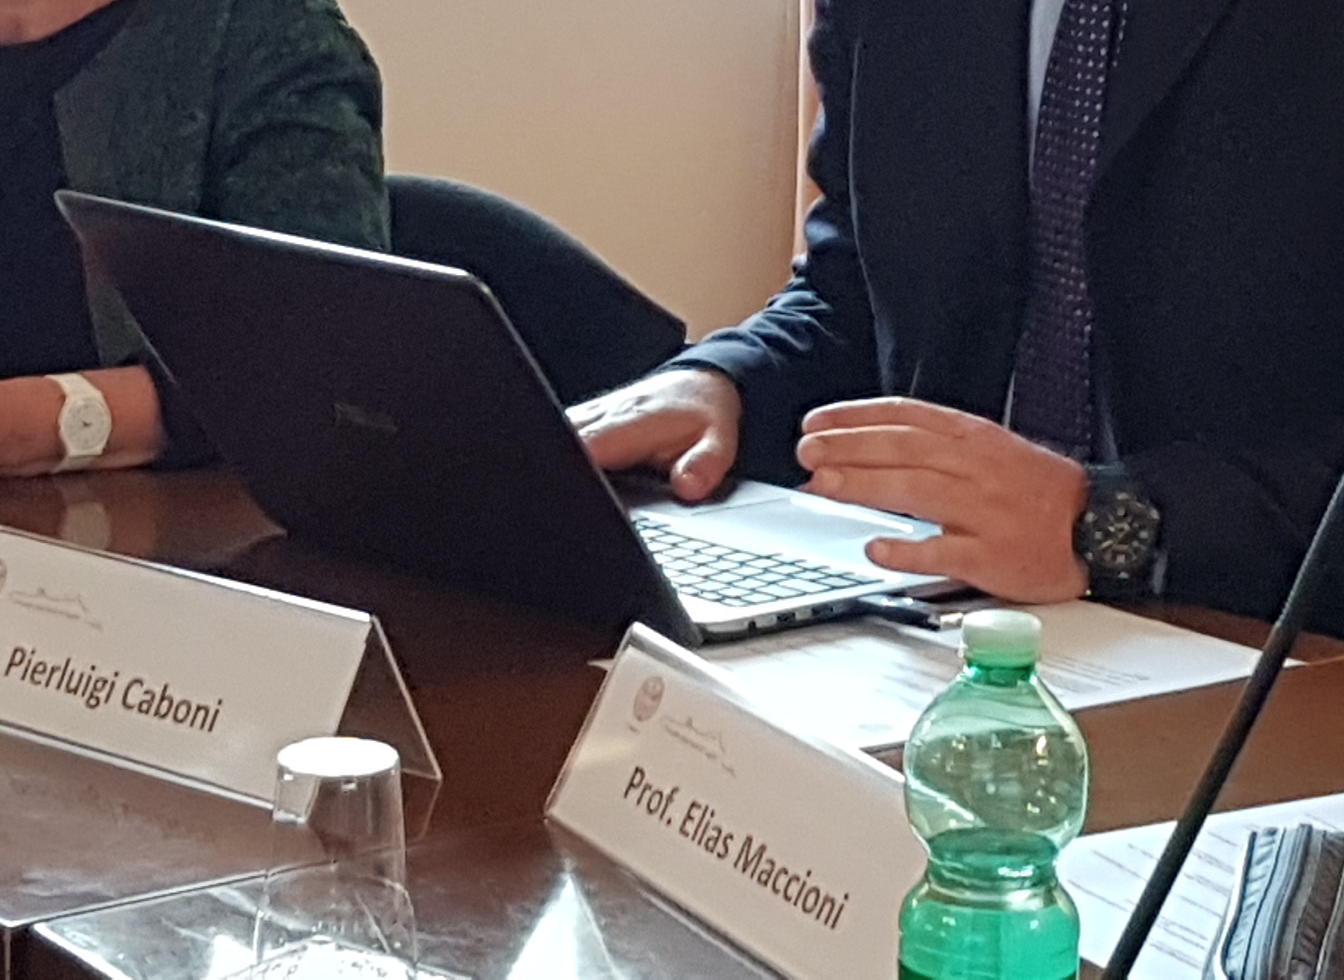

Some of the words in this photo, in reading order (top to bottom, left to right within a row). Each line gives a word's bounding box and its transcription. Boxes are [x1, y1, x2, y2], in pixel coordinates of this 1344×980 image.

[4, 646, 119, 710] Pierluigi
[121, 677, 223, 733] Caboni
[623, 766, 678, 827] Prof.
[678, 800, 735, 860] Elias
[733, 836, 850, 931] Maccioni
